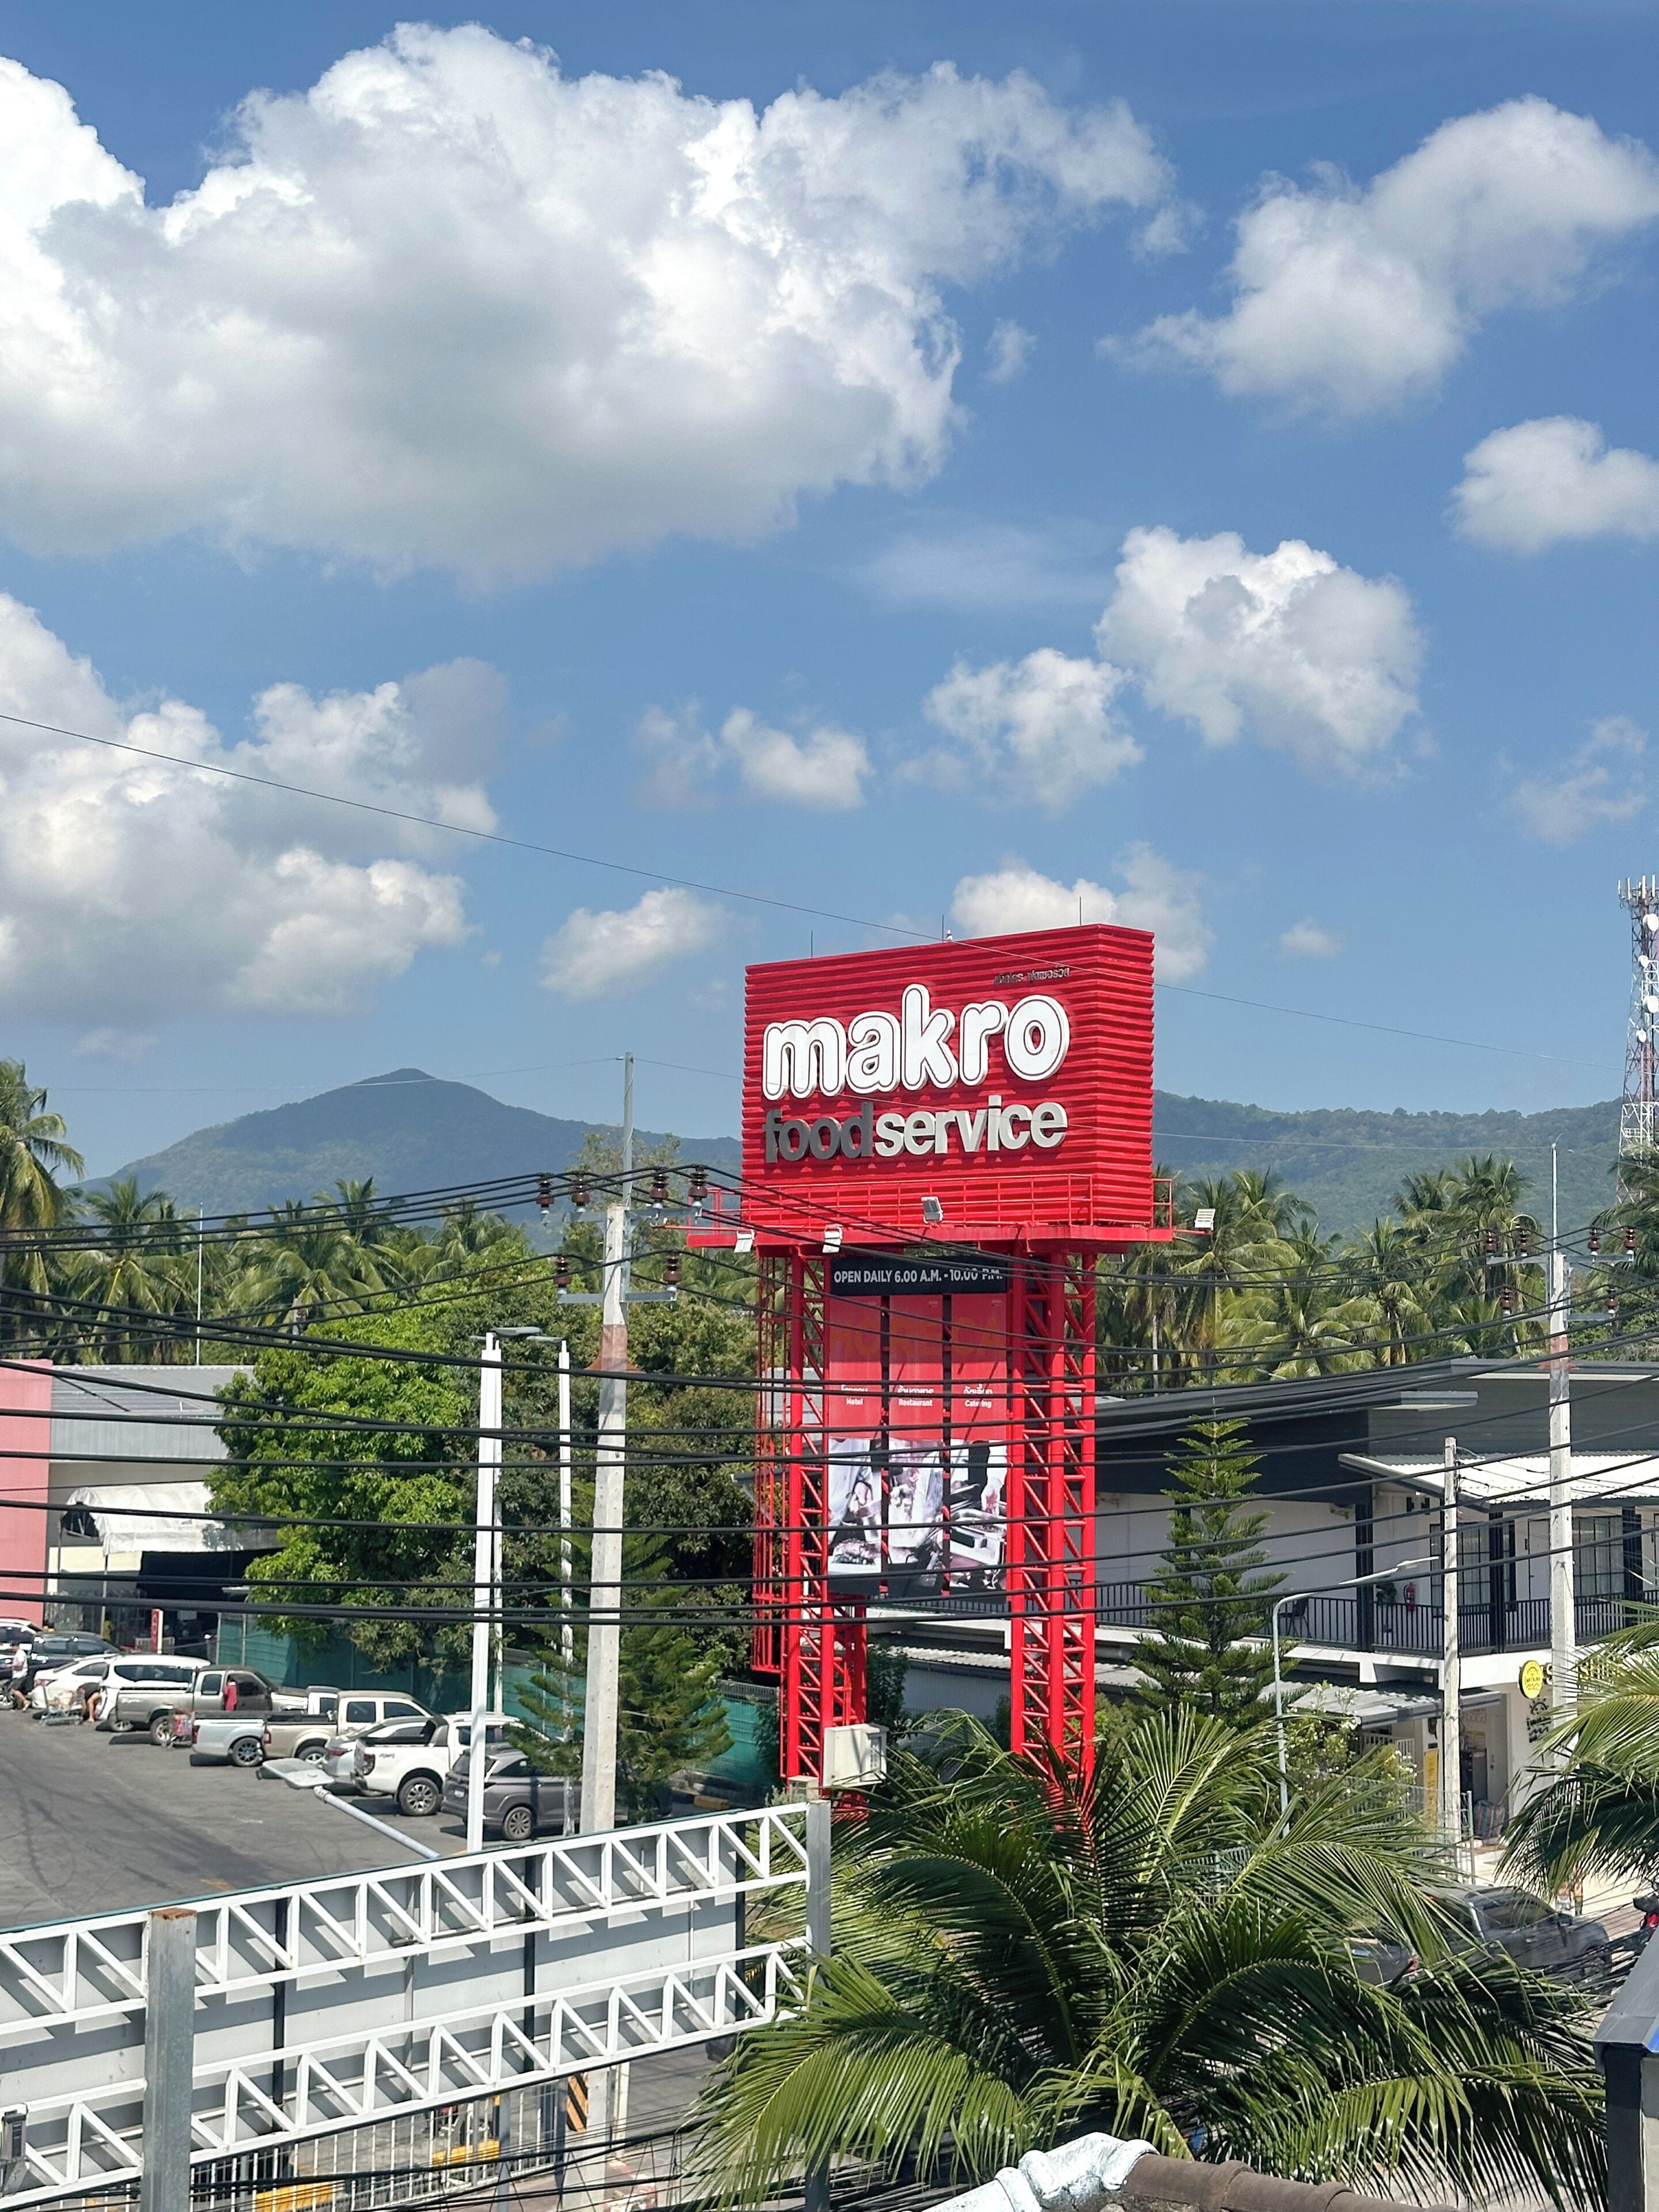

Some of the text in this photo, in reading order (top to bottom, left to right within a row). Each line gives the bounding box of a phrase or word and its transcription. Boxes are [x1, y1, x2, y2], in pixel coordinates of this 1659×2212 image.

[763, 984, 1070, 1100] makro
[763, 1095, 1067, 1162] foodservice
[834, 1270, 861, 1283] OPEN
[863, 1270, 892, 1283] DAILY
[894, 1270, 918, 1283] 6.00
[919, 1269, 942, 1282] A.M.
[949, 1268, 978, 1281] 10.00
[982, 1268, 1003, 1280] P.M.
[846, 1397, 863, 1406] Hotel
